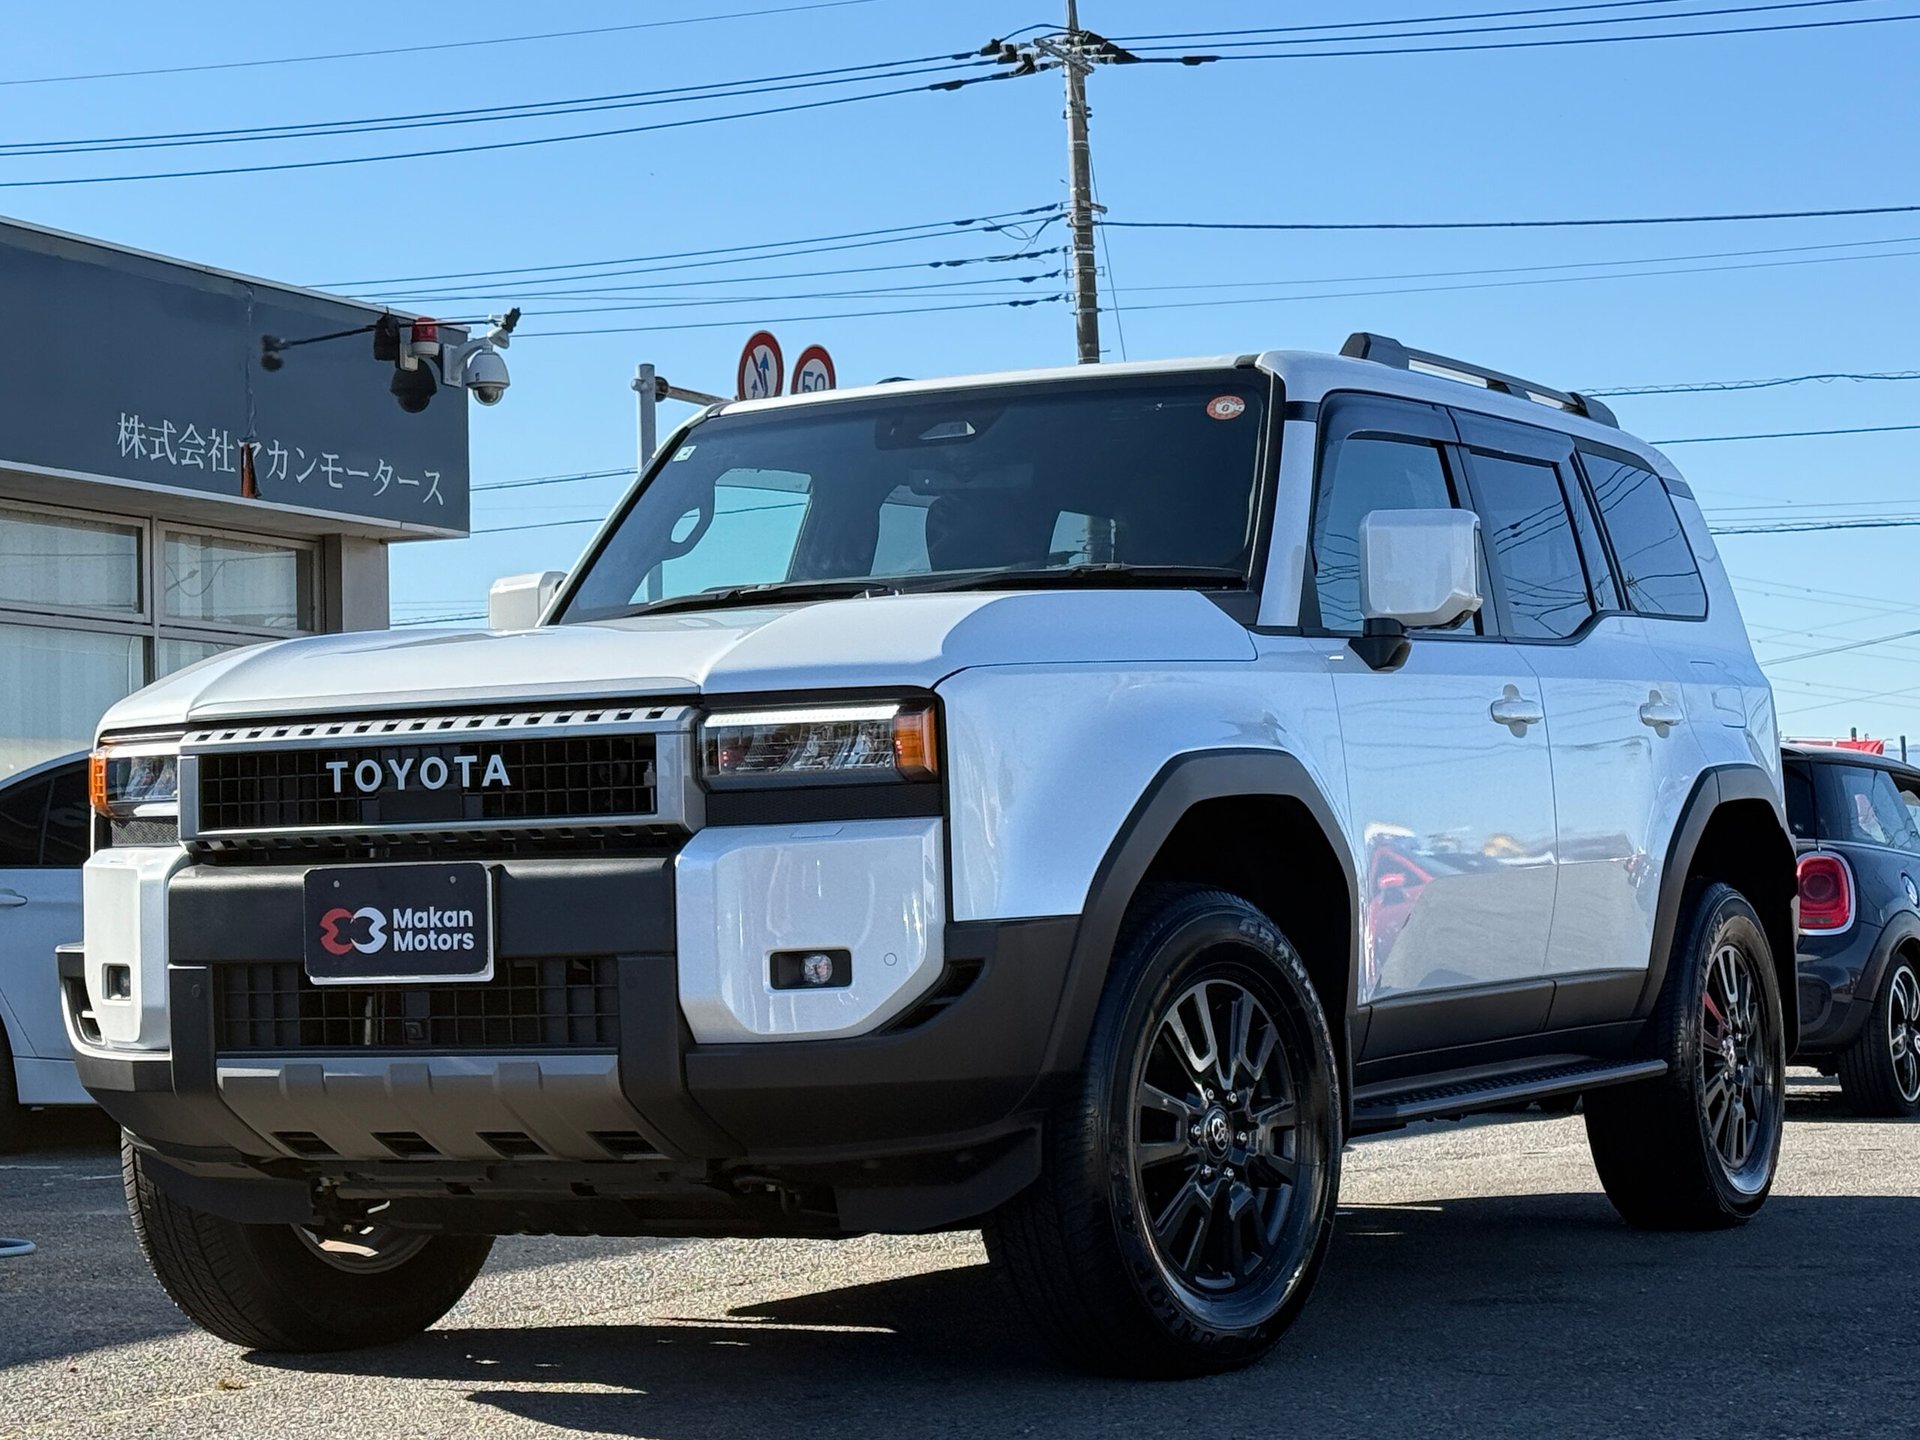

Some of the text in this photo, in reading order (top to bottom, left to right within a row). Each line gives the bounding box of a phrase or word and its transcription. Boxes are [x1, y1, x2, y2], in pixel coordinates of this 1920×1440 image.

[802, 371, 826, 392] 50
[325, 754, 511, 793] TOYOTA
[392, 906, 474, 929] Makan
[393, 930, 475, 951] Motors
